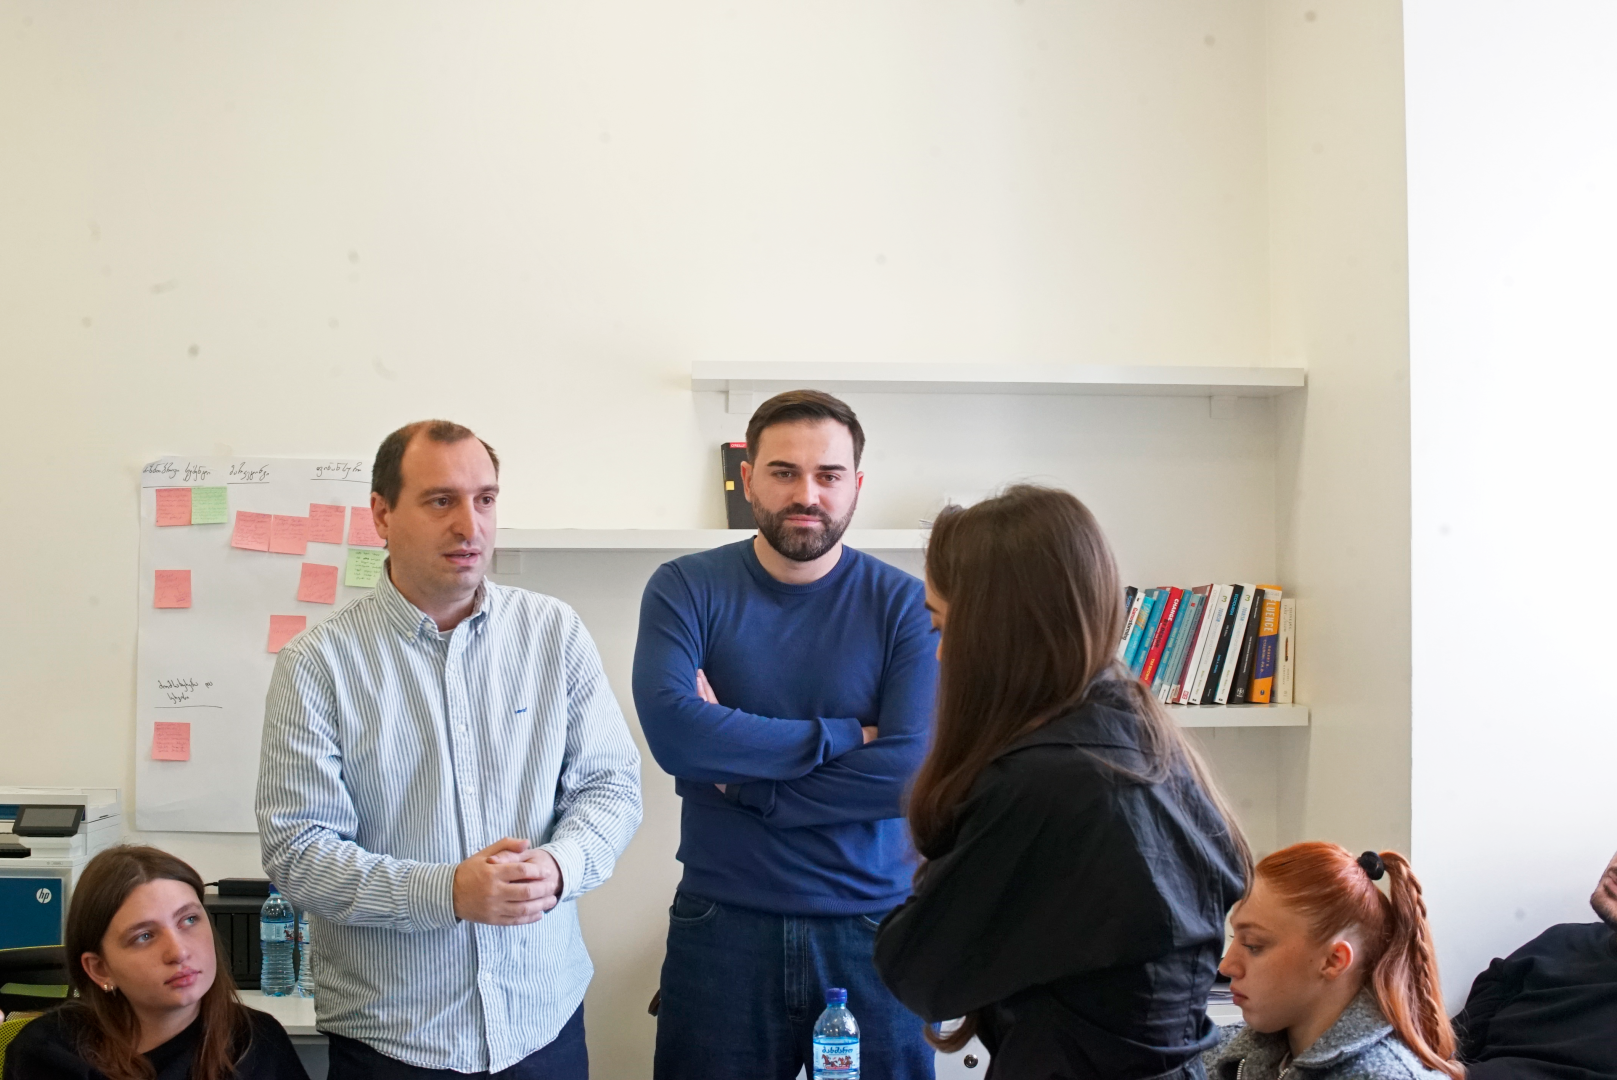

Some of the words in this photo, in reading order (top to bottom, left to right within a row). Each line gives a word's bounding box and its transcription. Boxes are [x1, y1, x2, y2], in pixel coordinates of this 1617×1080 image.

[1167, 598, 1181, 622] CHANGE
[1264, 600, 1277, 632] LUENCE
[1122, 607, 1139, 640] Gamestorming
[38, 888, 51, 904] hp
[821, 1045, 854, 1054] ბახმარო
